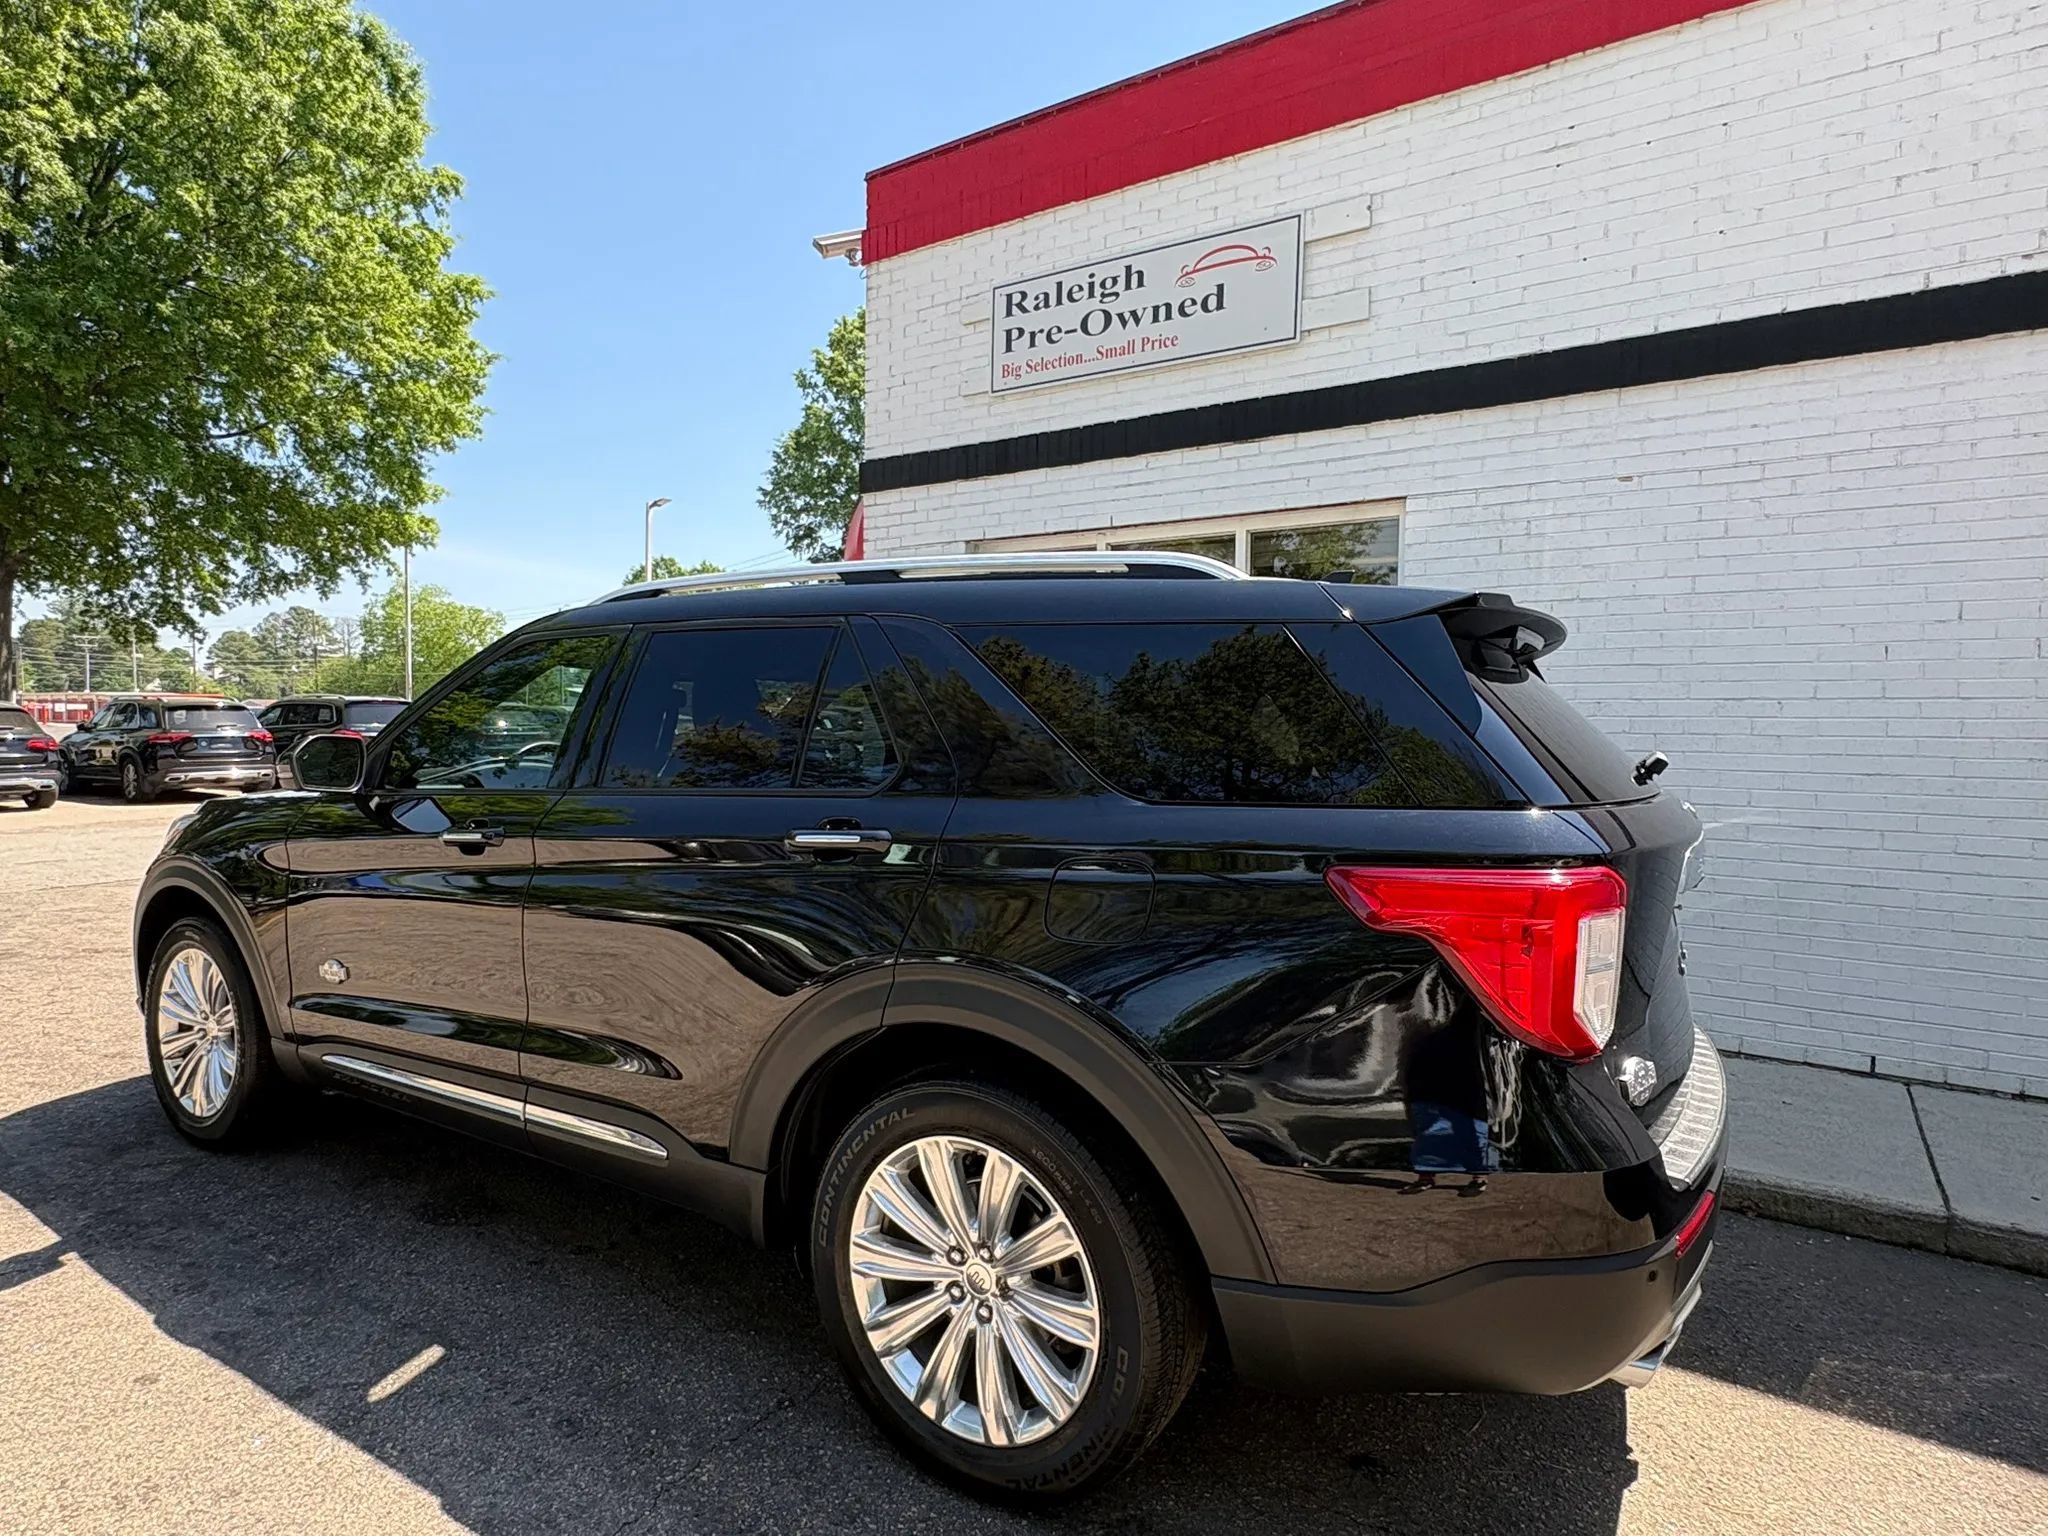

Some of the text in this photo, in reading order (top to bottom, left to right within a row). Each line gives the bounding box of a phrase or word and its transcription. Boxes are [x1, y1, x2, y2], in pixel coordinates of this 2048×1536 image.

[1001, 282, 1226, 355] Pre-Owned
[1002, 264, 1147, 319] Raleigh
[1001, 361, 1023, 381] Big
[1141, 333, 1179, 352] Price
[818, 1107, 916, 1248] CONTINENTAL
